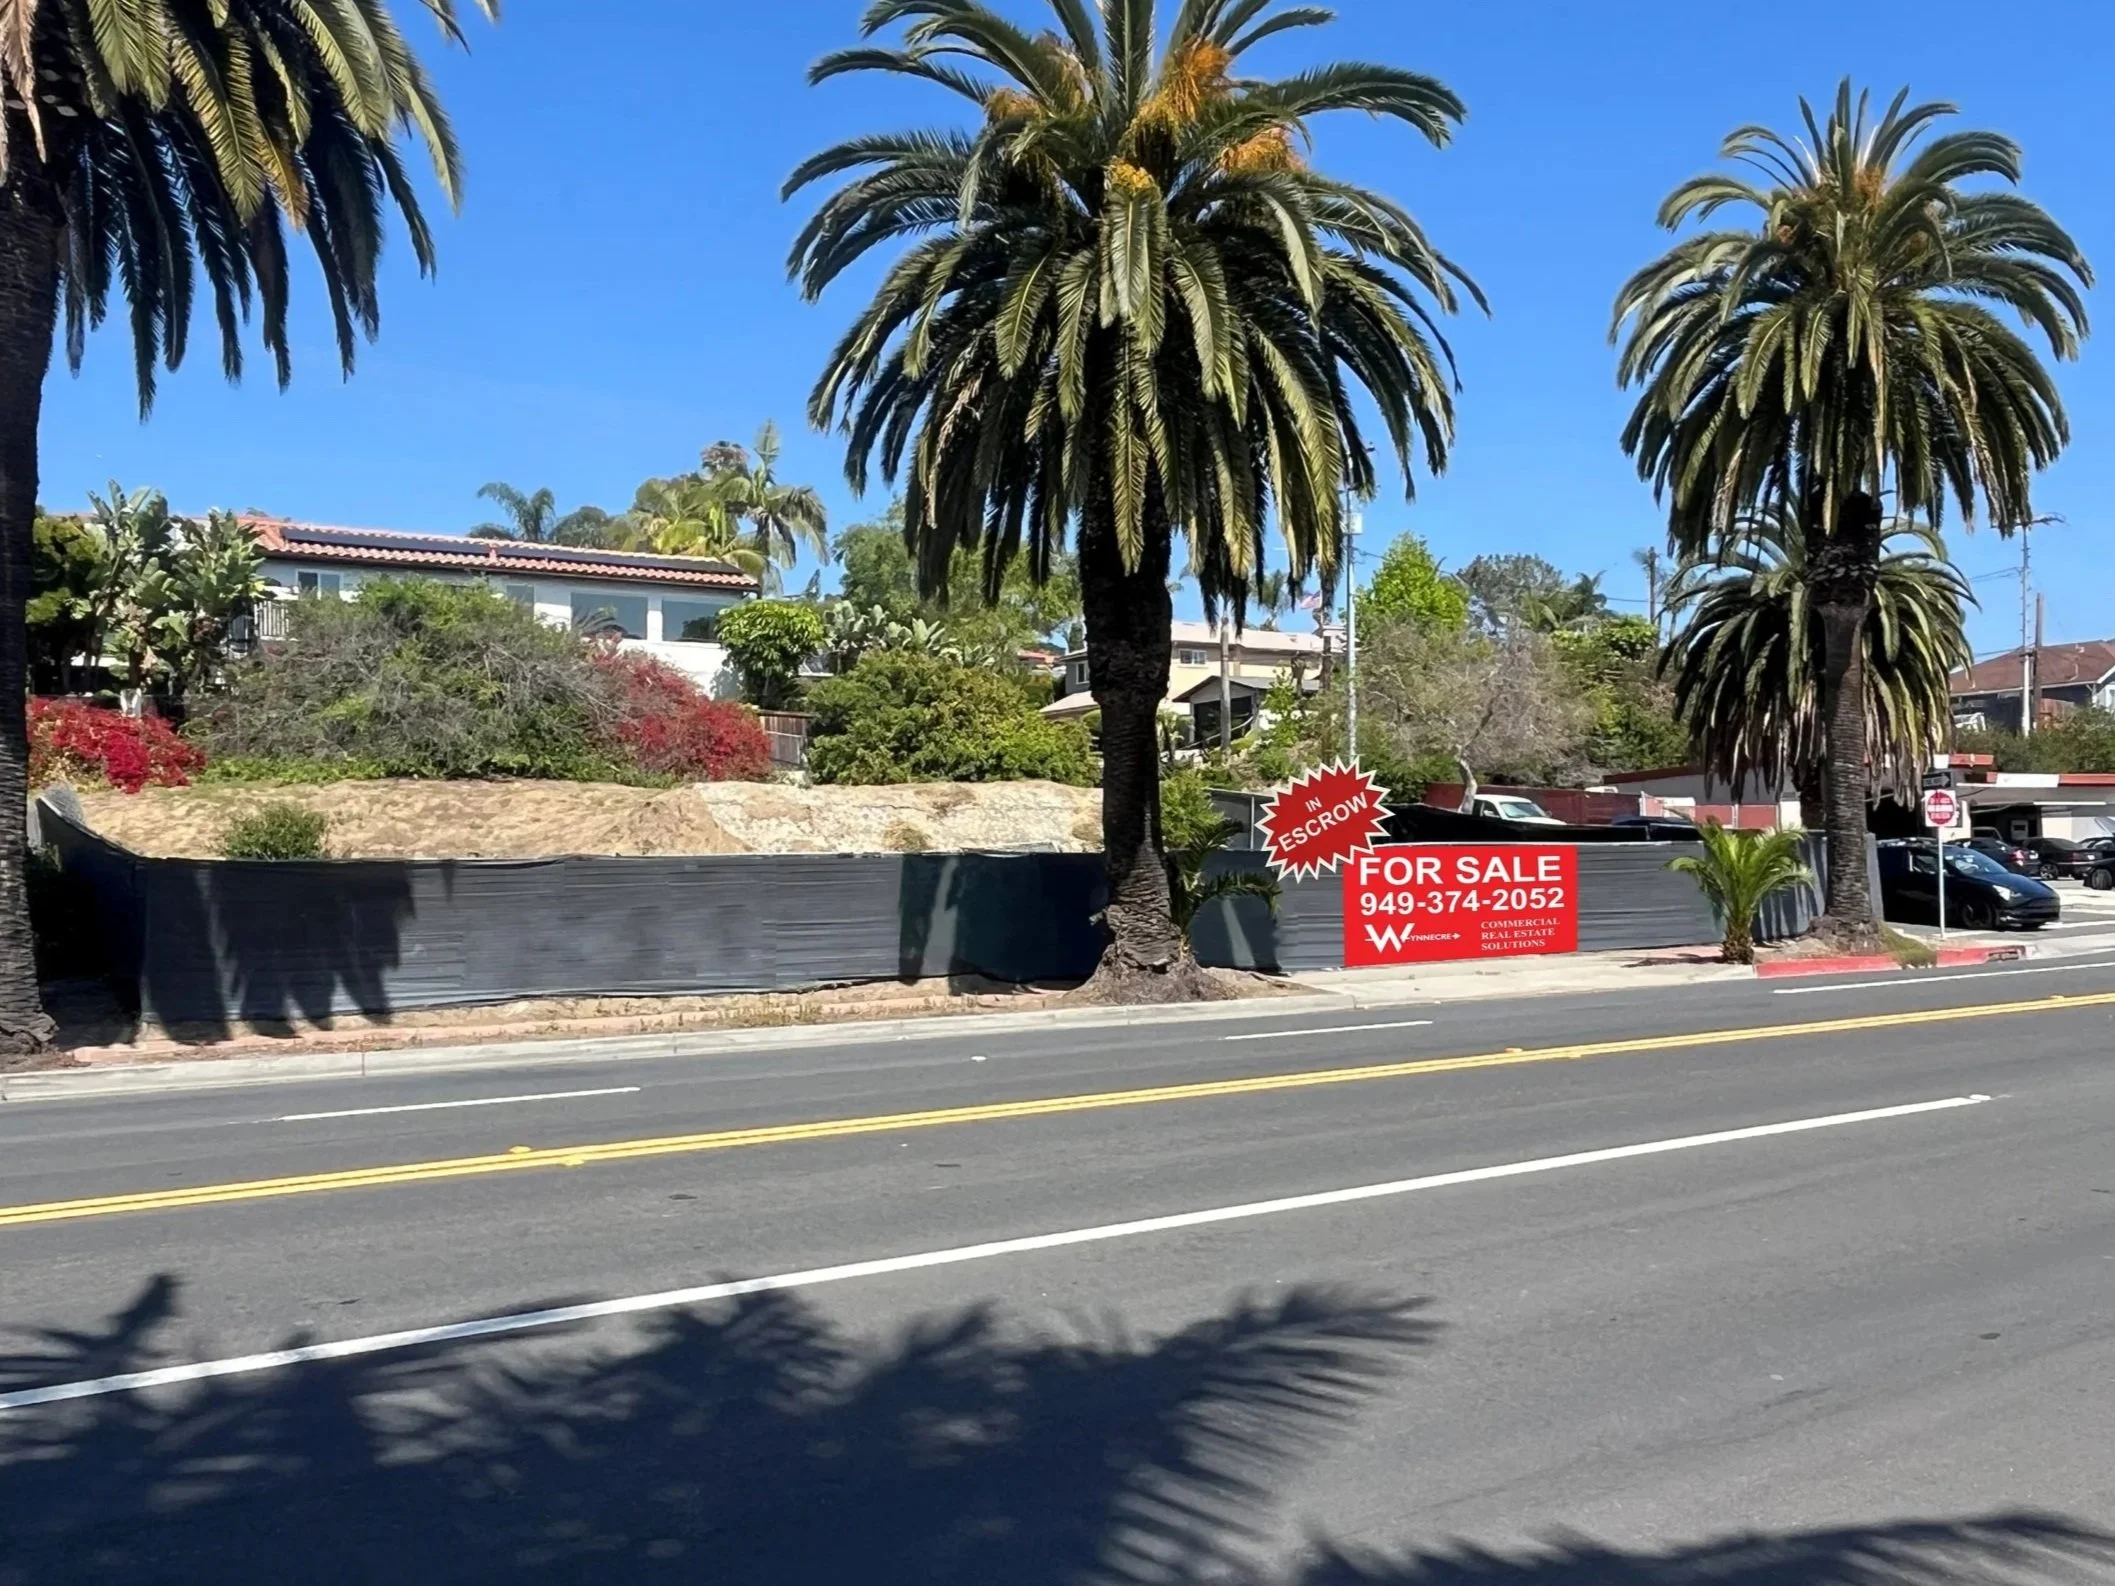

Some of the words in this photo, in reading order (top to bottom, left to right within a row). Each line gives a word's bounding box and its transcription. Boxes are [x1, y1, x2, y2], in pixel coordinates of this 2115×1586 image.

[1360, 856, 1443, 886] FOR
[1456, 855, 1562, 884] SALE
[1360, 887, 1565, 916] 949-374-2052
[1481, 917, 1560, 930] COMMERCIAL
[1481, 930, 1512, 940] REAL
[1514, 928, 1555, 939] ESTATE
[1481, 939, 1546, 951] SOLUTIONS
